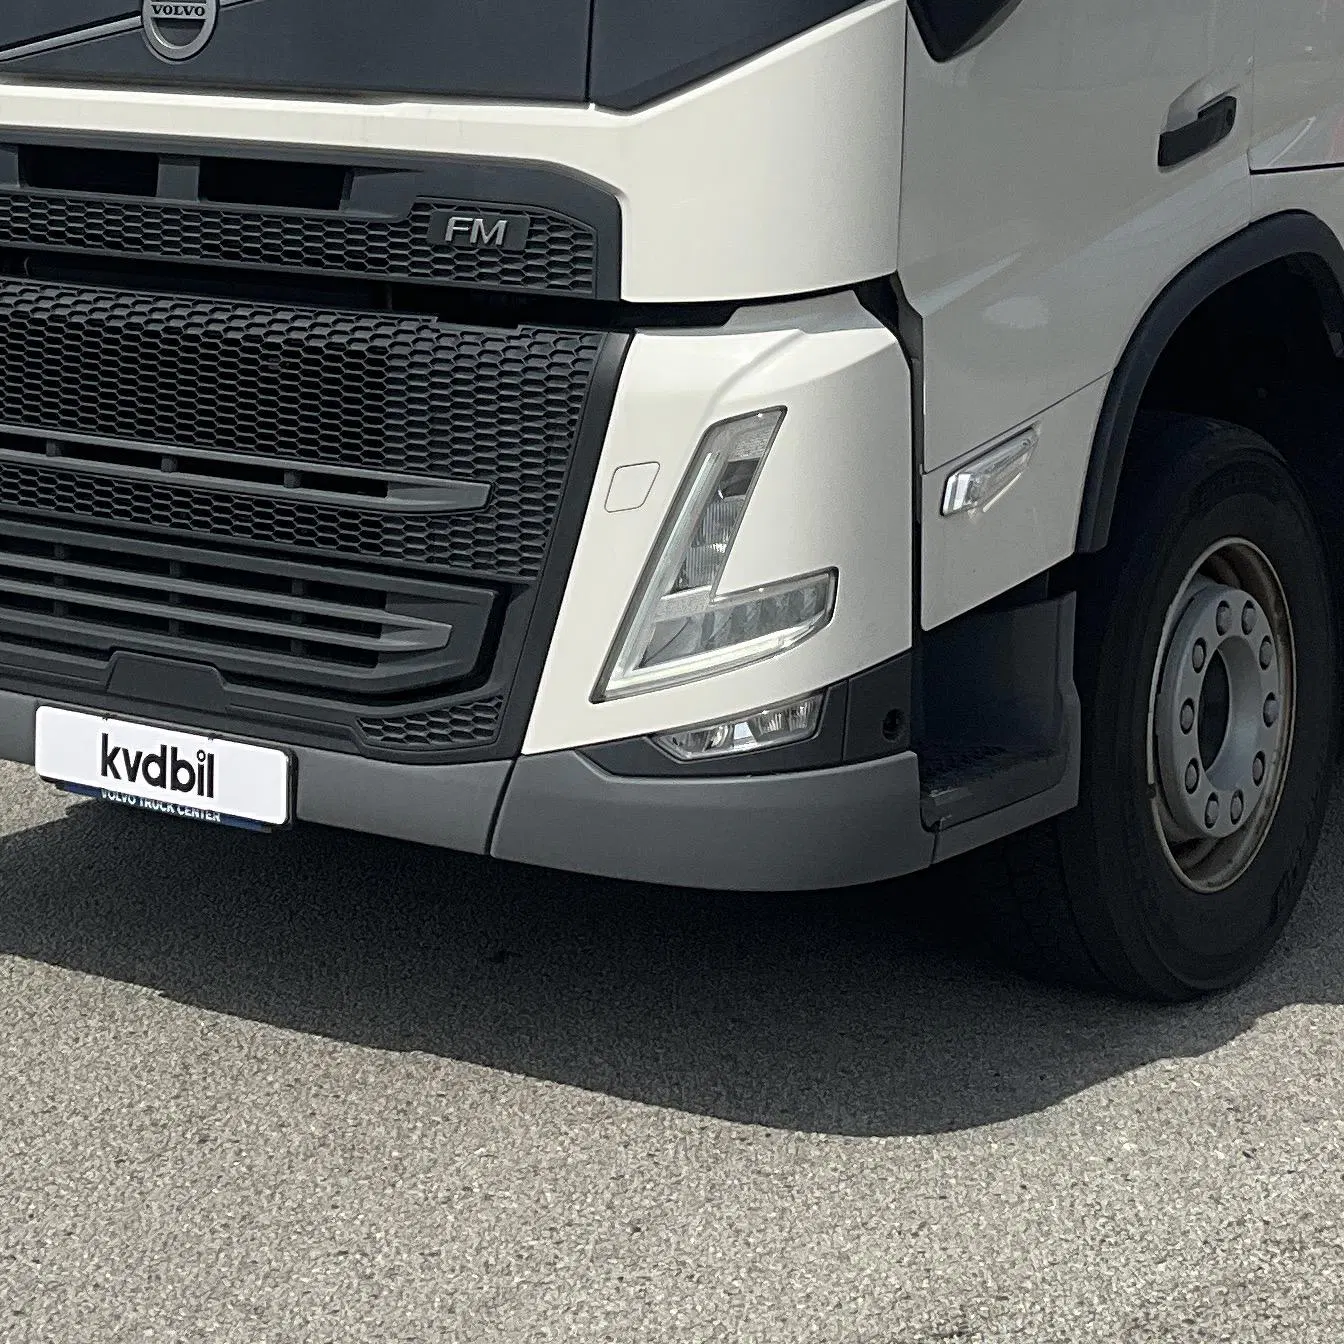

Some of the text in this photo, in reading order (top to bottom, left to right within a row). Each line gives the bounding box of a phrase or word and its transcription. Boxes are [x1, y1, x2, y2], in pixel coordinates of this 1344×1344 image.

[151, 3, 206, 18] VOLVO
[444, 215, 508, 246] FM
[100, 731, 215, 799] kvdbil
[101, 789, 221, 822] VOLVO TRUCK CENTER
